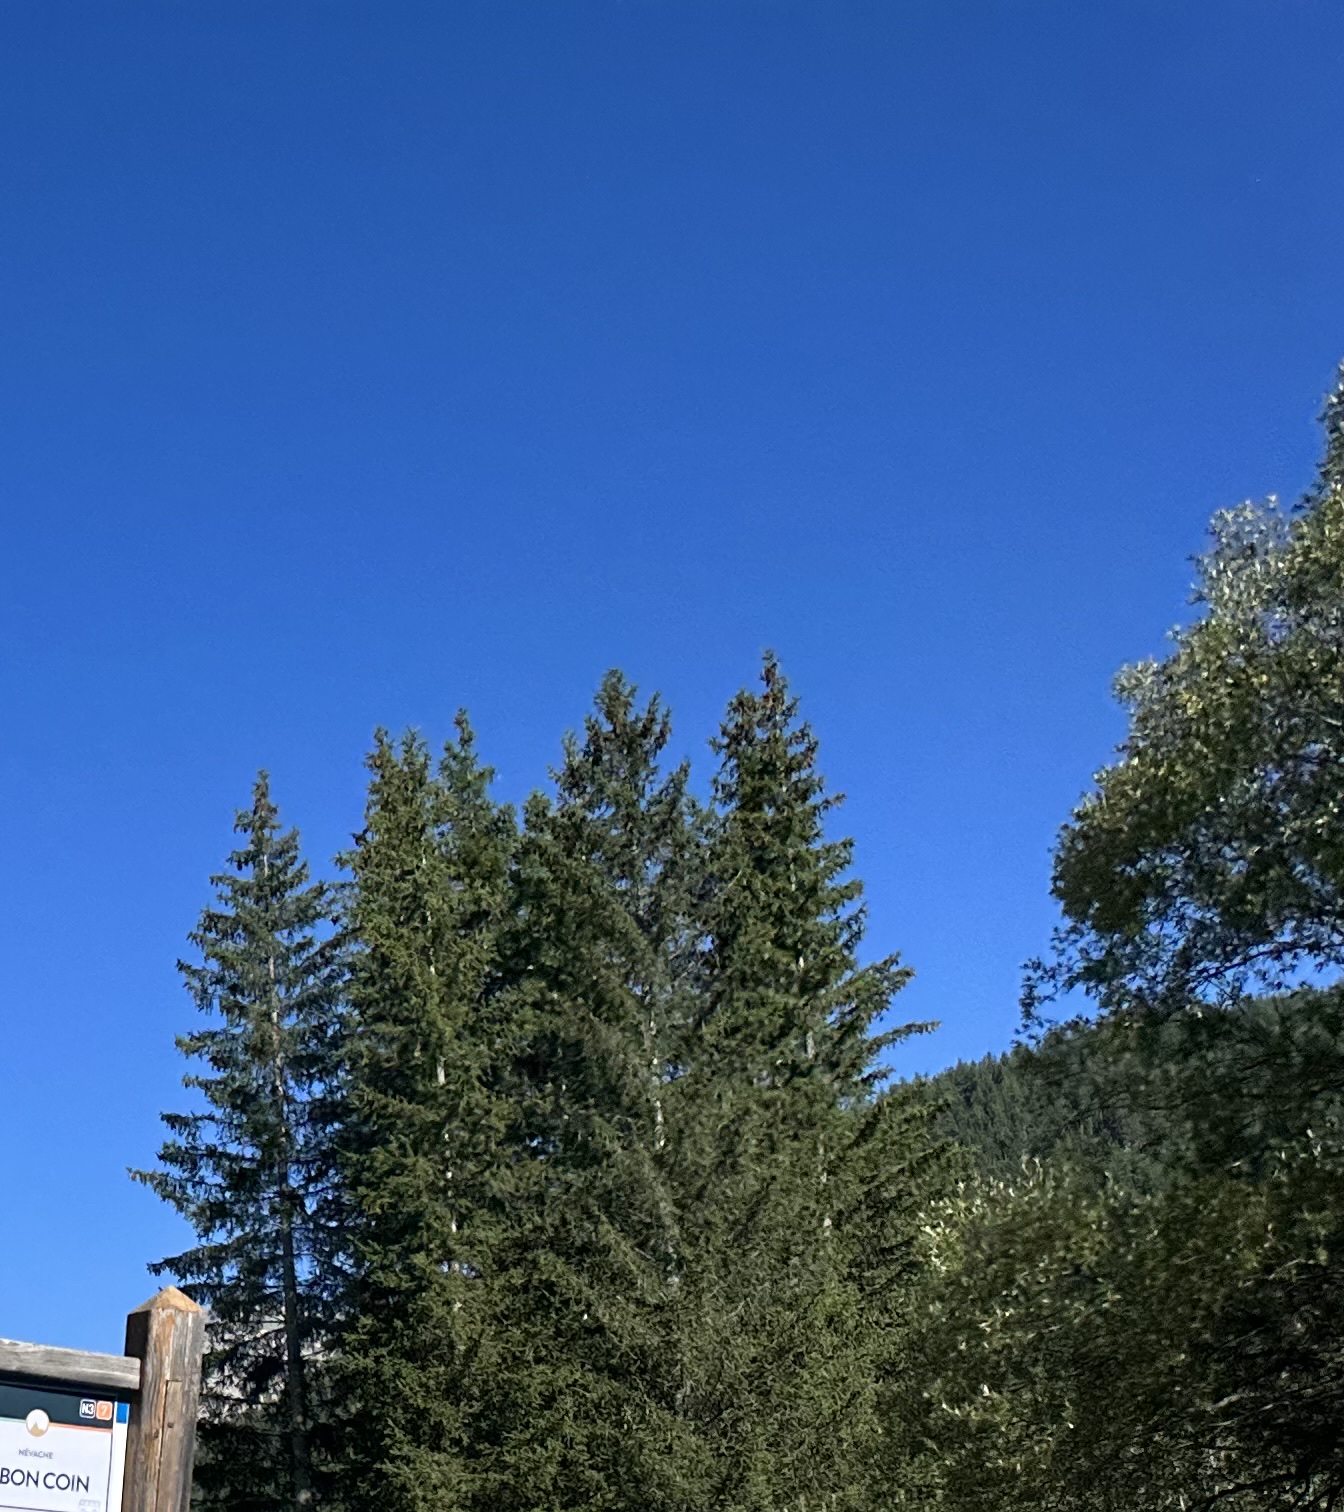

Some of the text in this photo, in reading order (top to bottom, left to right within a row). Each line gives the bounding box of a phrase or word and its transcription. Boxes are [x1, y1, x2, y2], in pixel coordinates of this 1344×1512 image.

[81, 1402, 95, 1416] N3
[18, 1448, 54, 1460] NÉVACHE
[0, 1467, 40, 1488] BON
[43, 1472, 90, 1493] COIN
